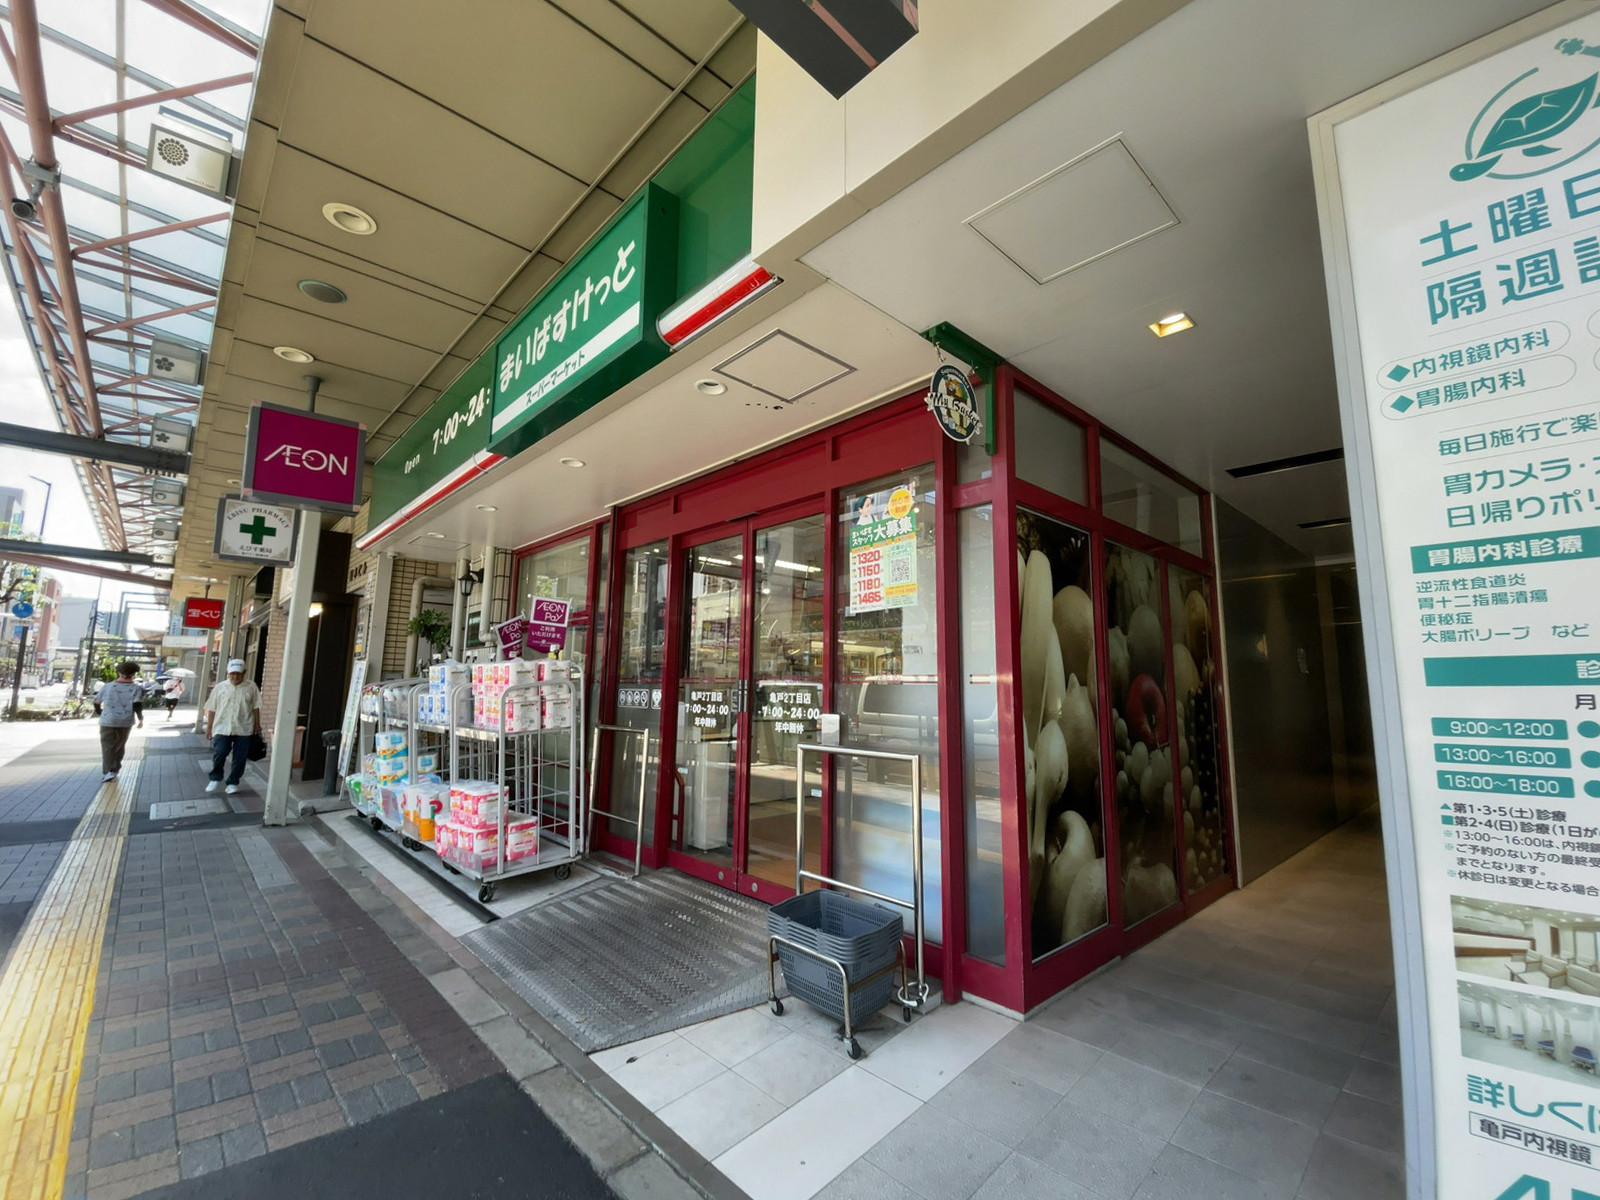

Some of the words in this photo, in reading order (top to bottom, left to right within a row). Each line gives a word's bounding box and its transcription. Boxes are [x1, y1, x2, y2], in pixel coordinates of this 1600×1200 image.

[1419, 168, 1600, 267] 土曜日
[500, 240, 635, 393] まいばすけっと
[1412, 328, 1550, 378] 内視鏡内科
[526, 350, 585, 405] スーパーマーケット
[1416, 368, 1525, 409] 胃腸内科
[1438, 411, 1600, 456] 毎日施行で楽
[227, 507, 249, 520] EBISU
[252, 507, 289, 529] PHARMACY
[857, 550, 880, 564] 1320
[1428, 535, 1583, 566] 胃腸内科診療
[858, 564, 880, 577] 1150
[857, 578, 880, 591] 1180
[1416, 573, 1526, 593] 逆流性食道炎
[858, 591, 882, 604] 1465
[1417, 589, 1548, 610] 胃十二指腸潰瘍
[1420, 612, 1473, 626] 便秘症
[1422, 626, 1530, 643] 大腸ポリープ
[1552, 623, 1590, 638] など
[1576, 660, 1600, 679] 診
[770, 692, 811, 704] 亀戸2丁目店
[1575, 694, 1596, 710] 月
[1453, 816, 1600, 838] 第2・4(日)診療(1日が
[1456, 856, 1546, 876] までとなります。
[1458, 870, 1600, 897] 休診日は変更となる場合
[1479, 1118, 1591, 1164] 亀戸内視鏡
